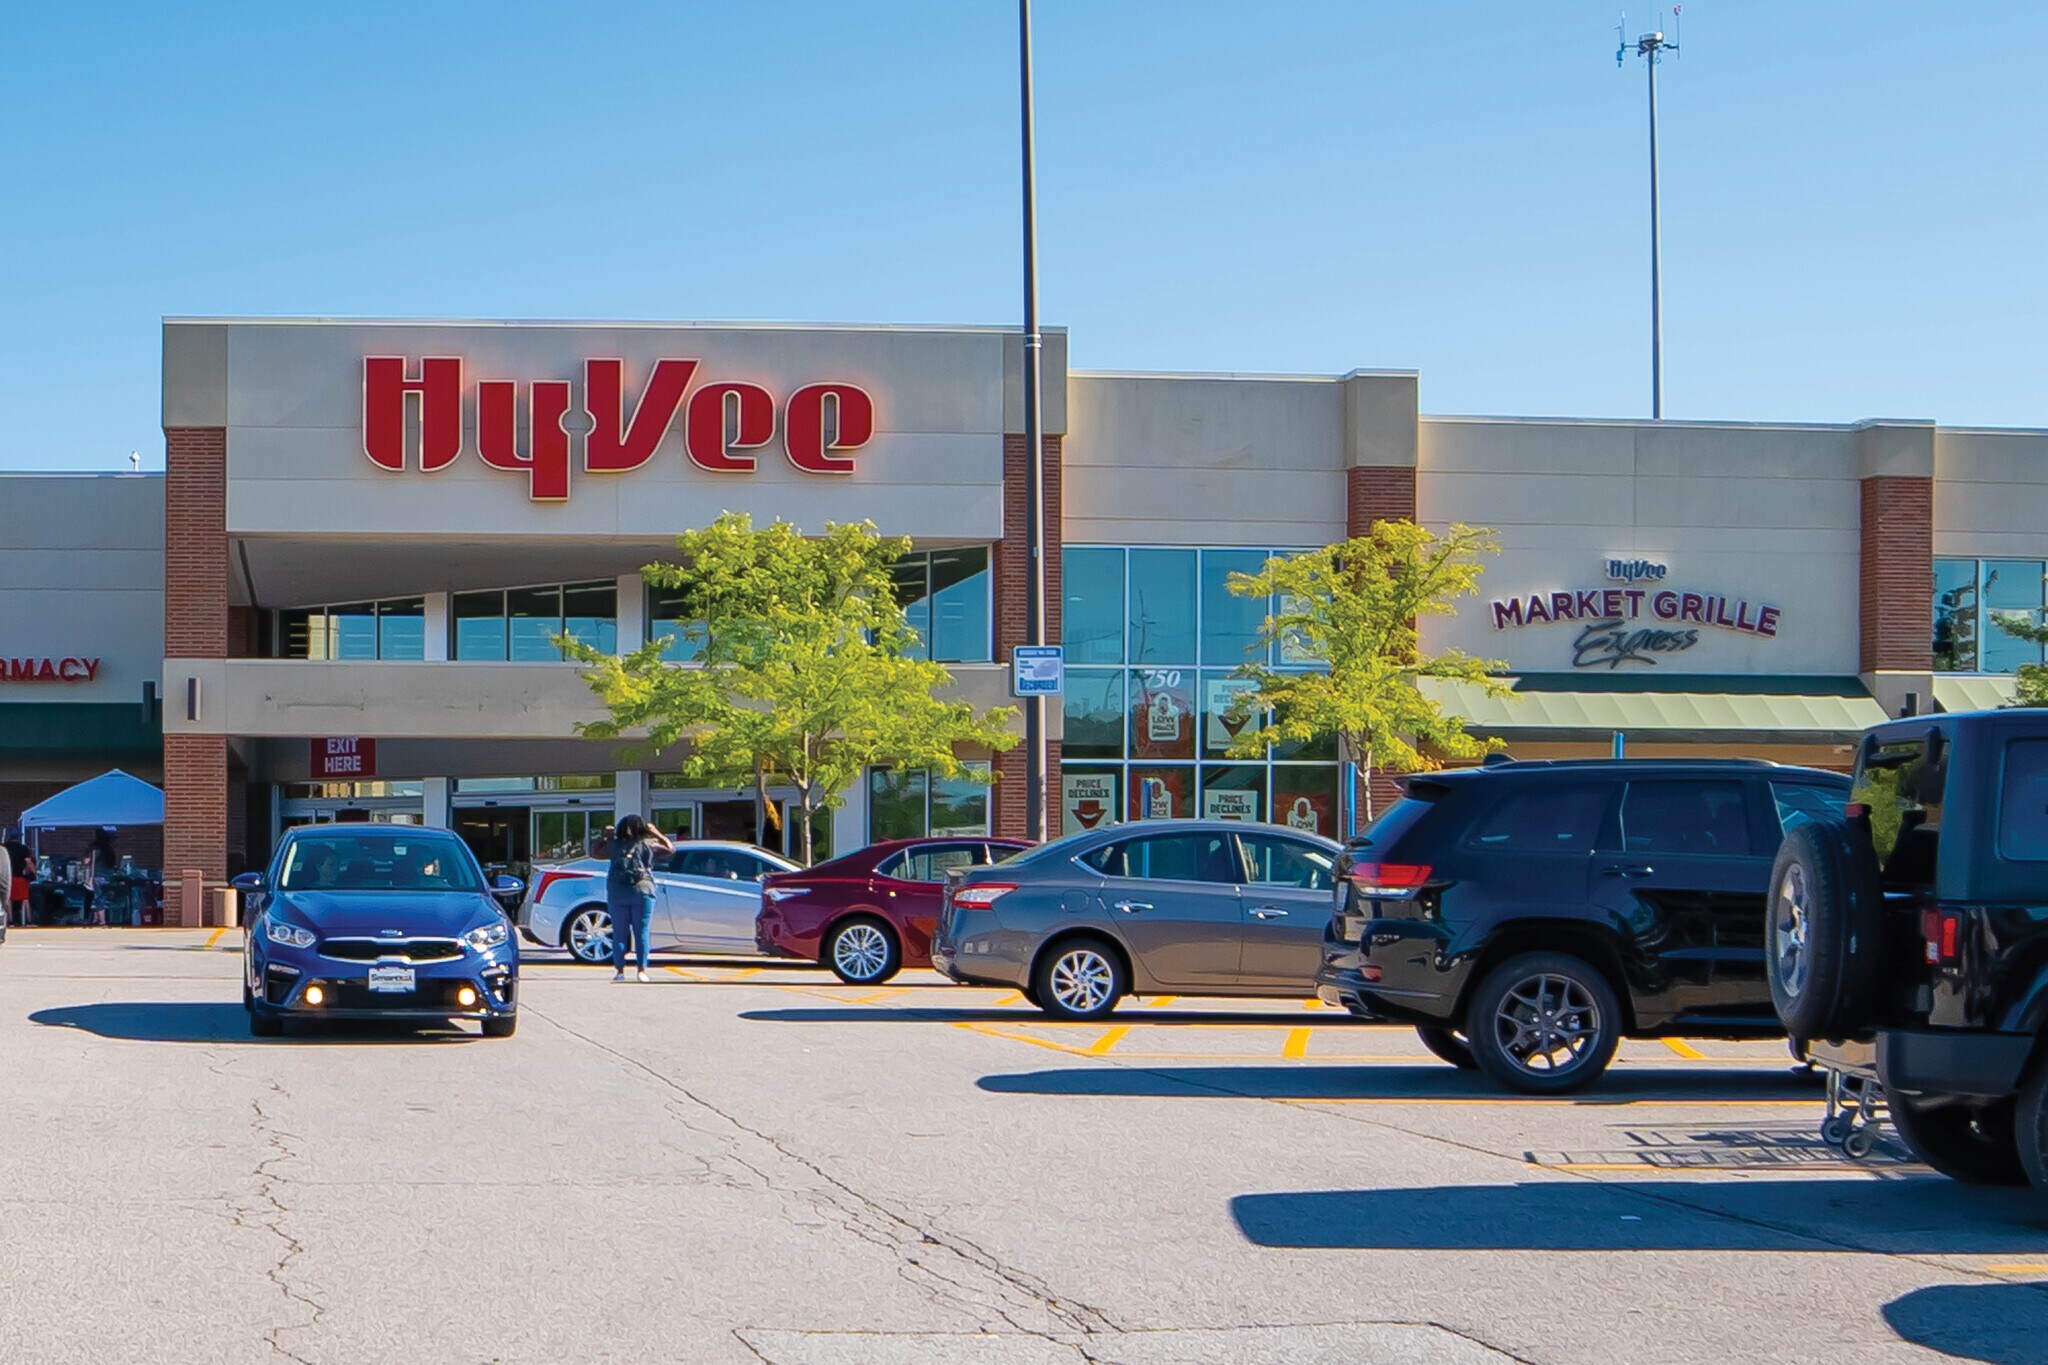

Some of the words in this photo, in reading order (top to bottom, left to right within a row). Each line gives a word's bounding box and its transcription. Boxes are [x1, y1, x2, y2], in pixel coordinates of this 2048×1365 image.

[362, 354, 875, 502] HyVee
[1491, 588, 1646, 630] MARKET
[1652, 588, 1782, 637] GRILLE
[1572, 618, 1699, 669] Express
[1144, 669, 1181, 688] 750
[327, 737, 359, 753] EXIT
[325, 755, 361, 772] HERE
[1076, 779, 1102, 788] PRICE
[1068, 788, 1110, 798] DECLINES
[1218, 794, 1243, 804] PRICE
[1210, 803, 1251, 814] DECLINES
